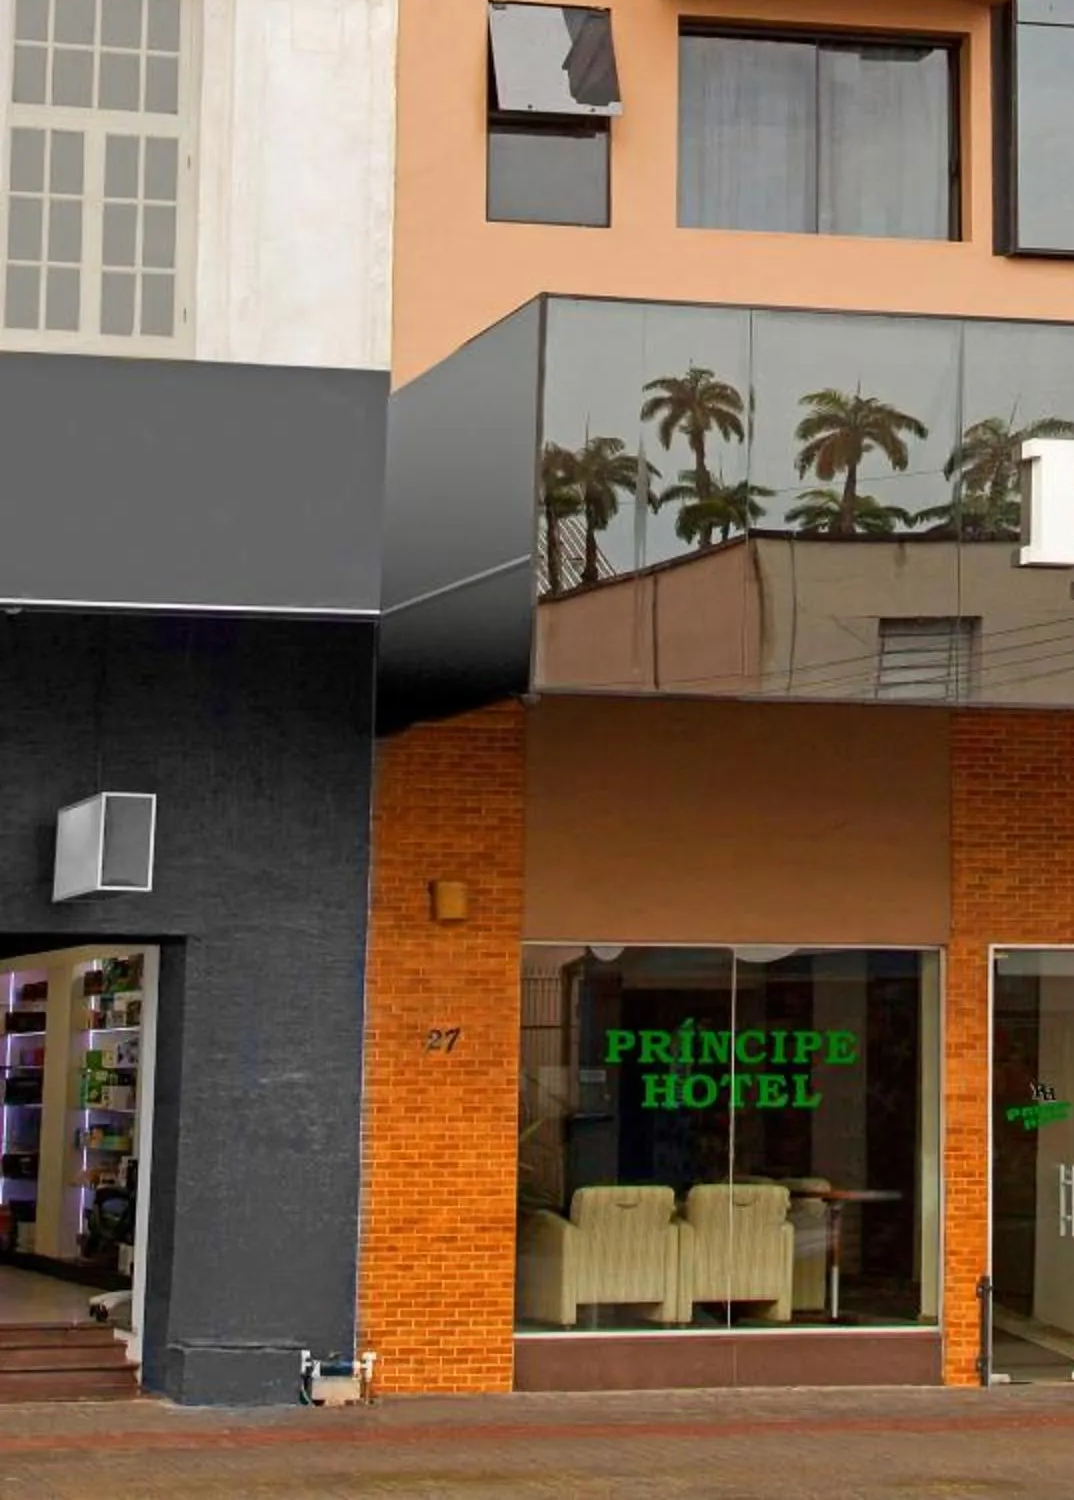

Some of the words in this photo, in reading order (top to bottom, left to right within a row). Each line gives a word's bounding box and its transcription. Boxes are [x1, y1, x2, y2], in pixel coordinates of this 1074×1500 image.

[427, 1027, 461, 1055] 27
[604, 1017, 859, 1064] PRÍNCIPE
[641, 1074, 823, 1108] HOTEL
